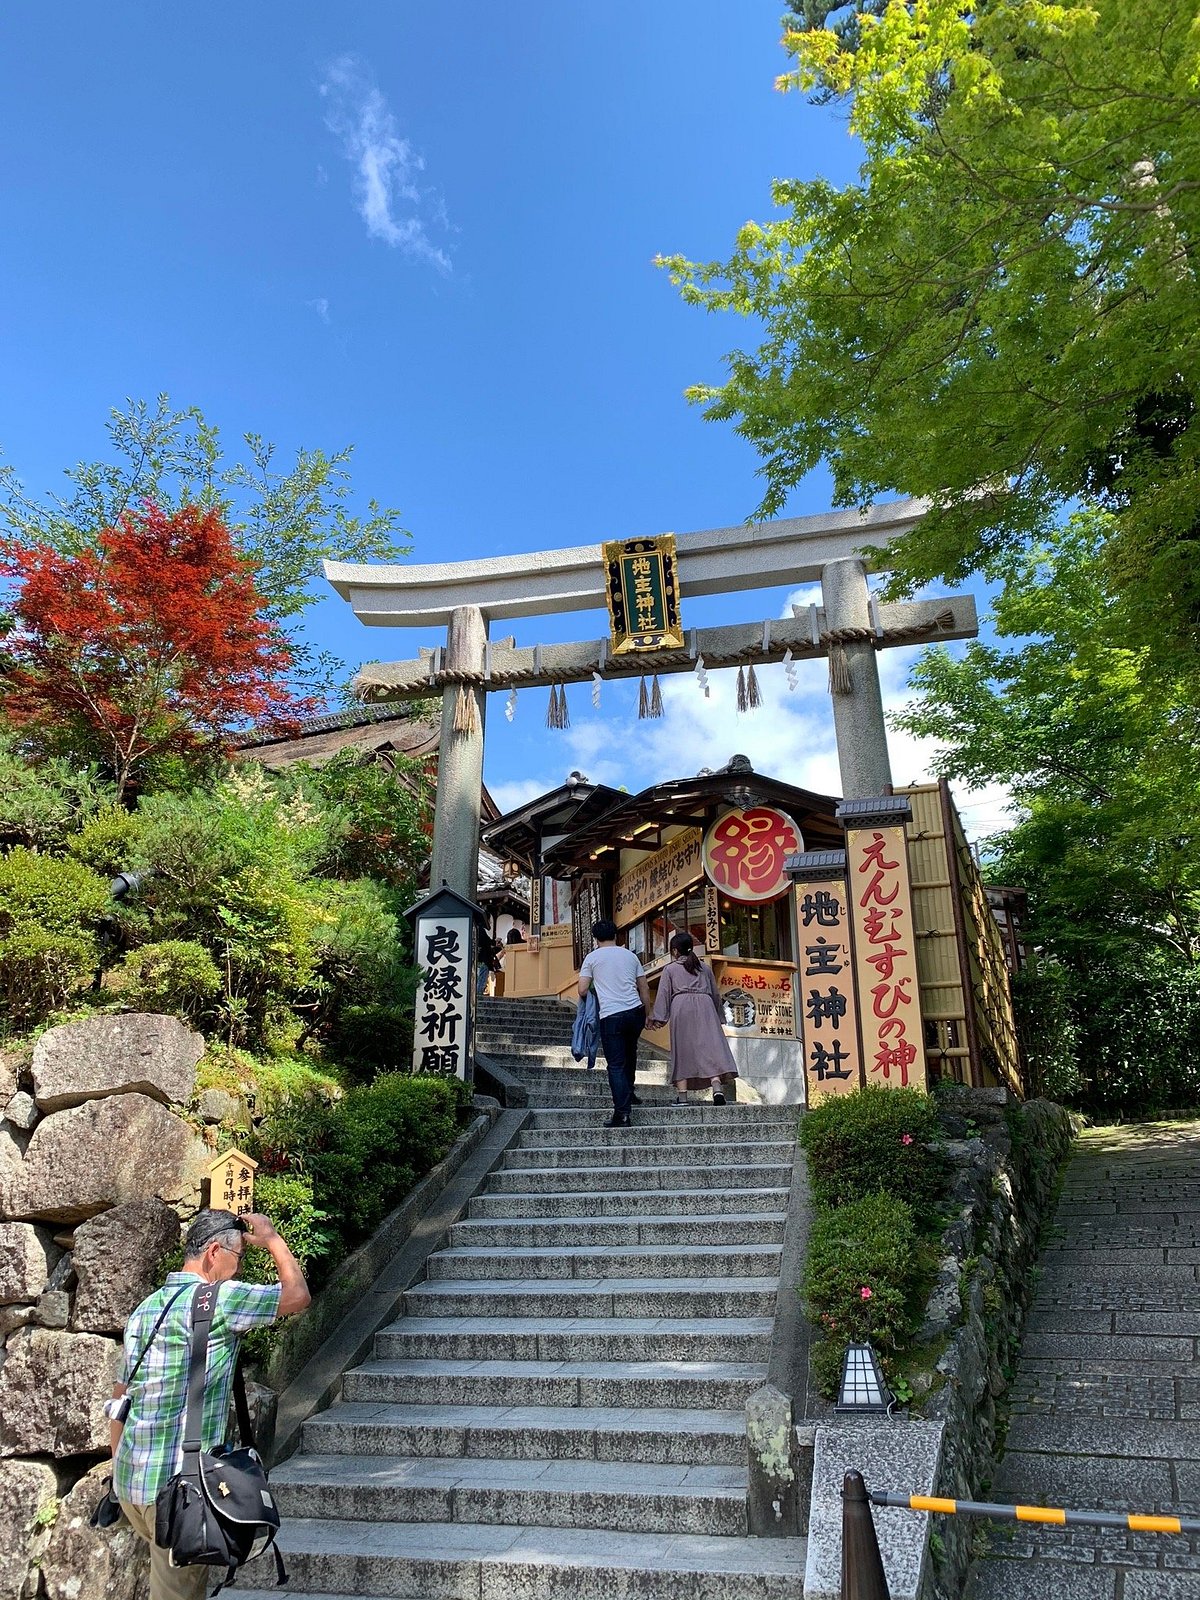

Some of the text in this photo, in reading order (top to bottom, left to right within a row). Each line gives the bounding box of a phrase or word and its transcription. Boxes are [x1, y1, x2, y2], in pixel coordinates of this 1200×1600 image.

[632, 558, 657, 630] 地主神社
[710, 808, 798, 894] 縁
[419, 925, 463, 1074] 良縁祈願
[758, 1004, 772, 1016] LOVE
[774, 1005, 792, 1018] STONE
[800, 890, 853, 1081] 地主神社
[858, 832, 917, 1088] えんむすびの神
